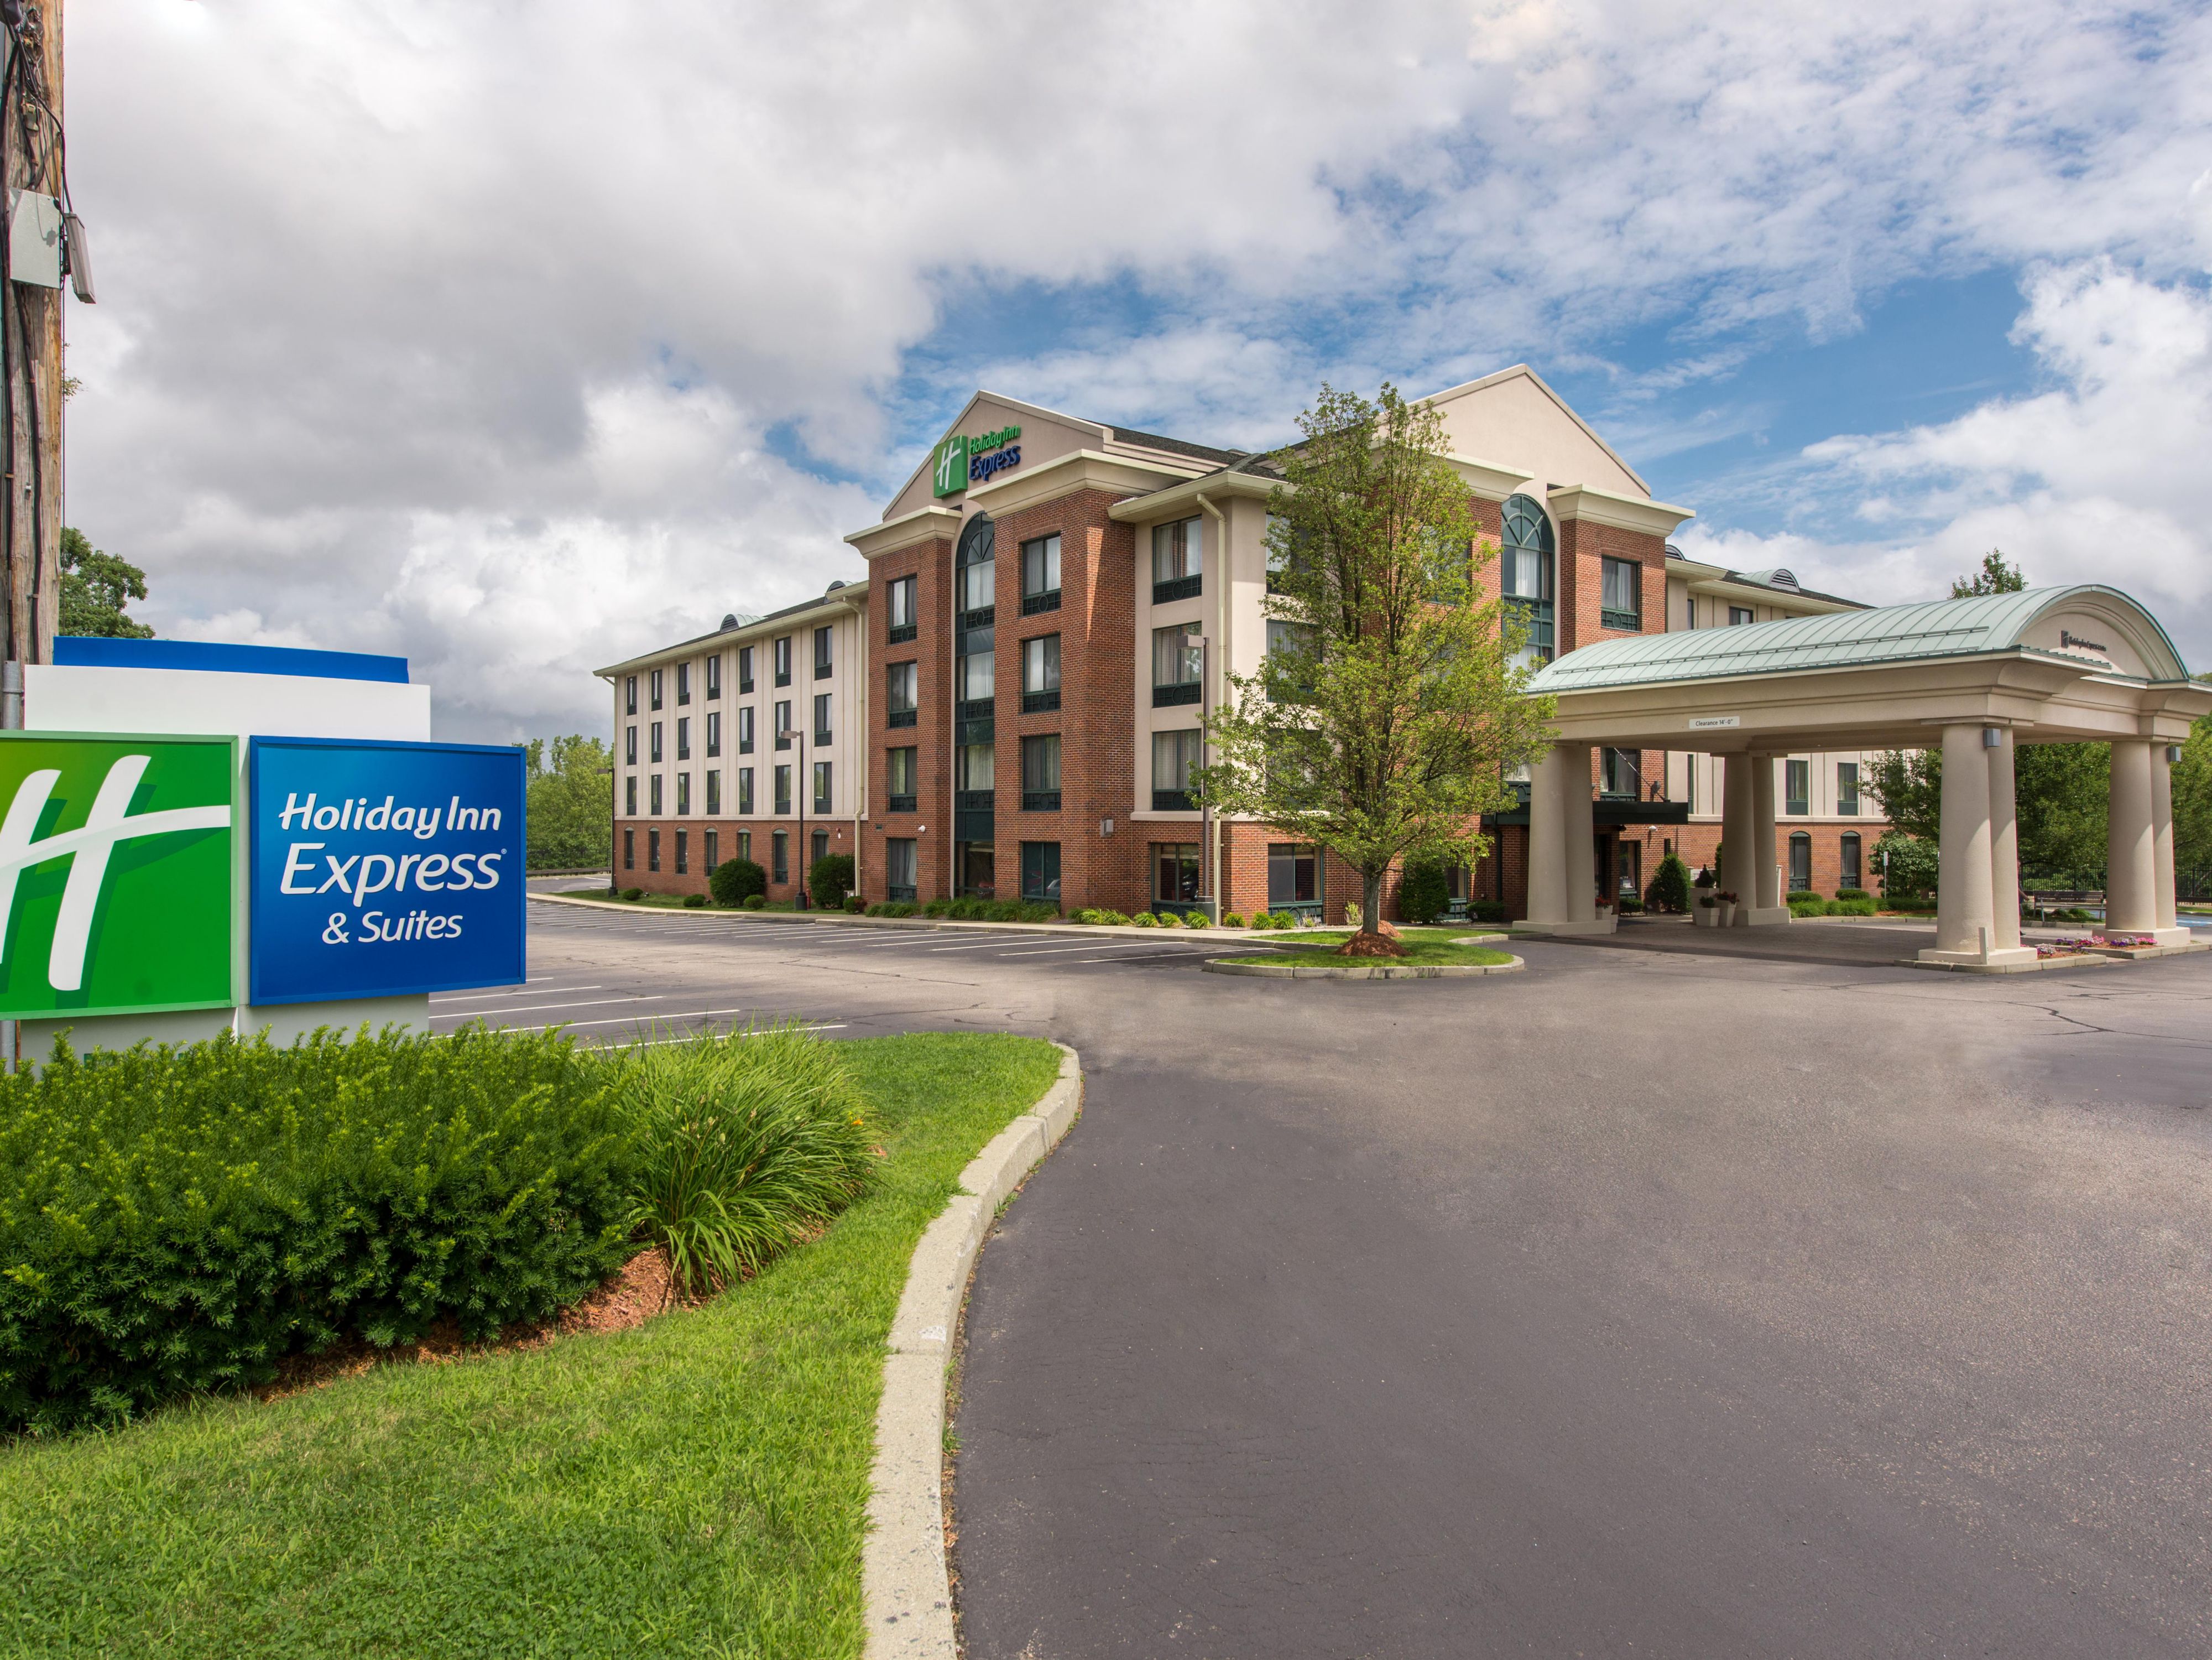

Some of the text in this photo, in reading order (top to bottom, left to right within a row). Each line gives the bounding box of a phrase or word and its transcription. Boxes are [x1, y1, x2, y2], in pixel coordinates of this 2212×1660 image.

[969, 425, 1021, 455] Holiday Inn
[969, 445, 1021, 482] Express
[278, 793, 502, 839] Holiday Inn
[322, 910, 463, 944] & Suites
